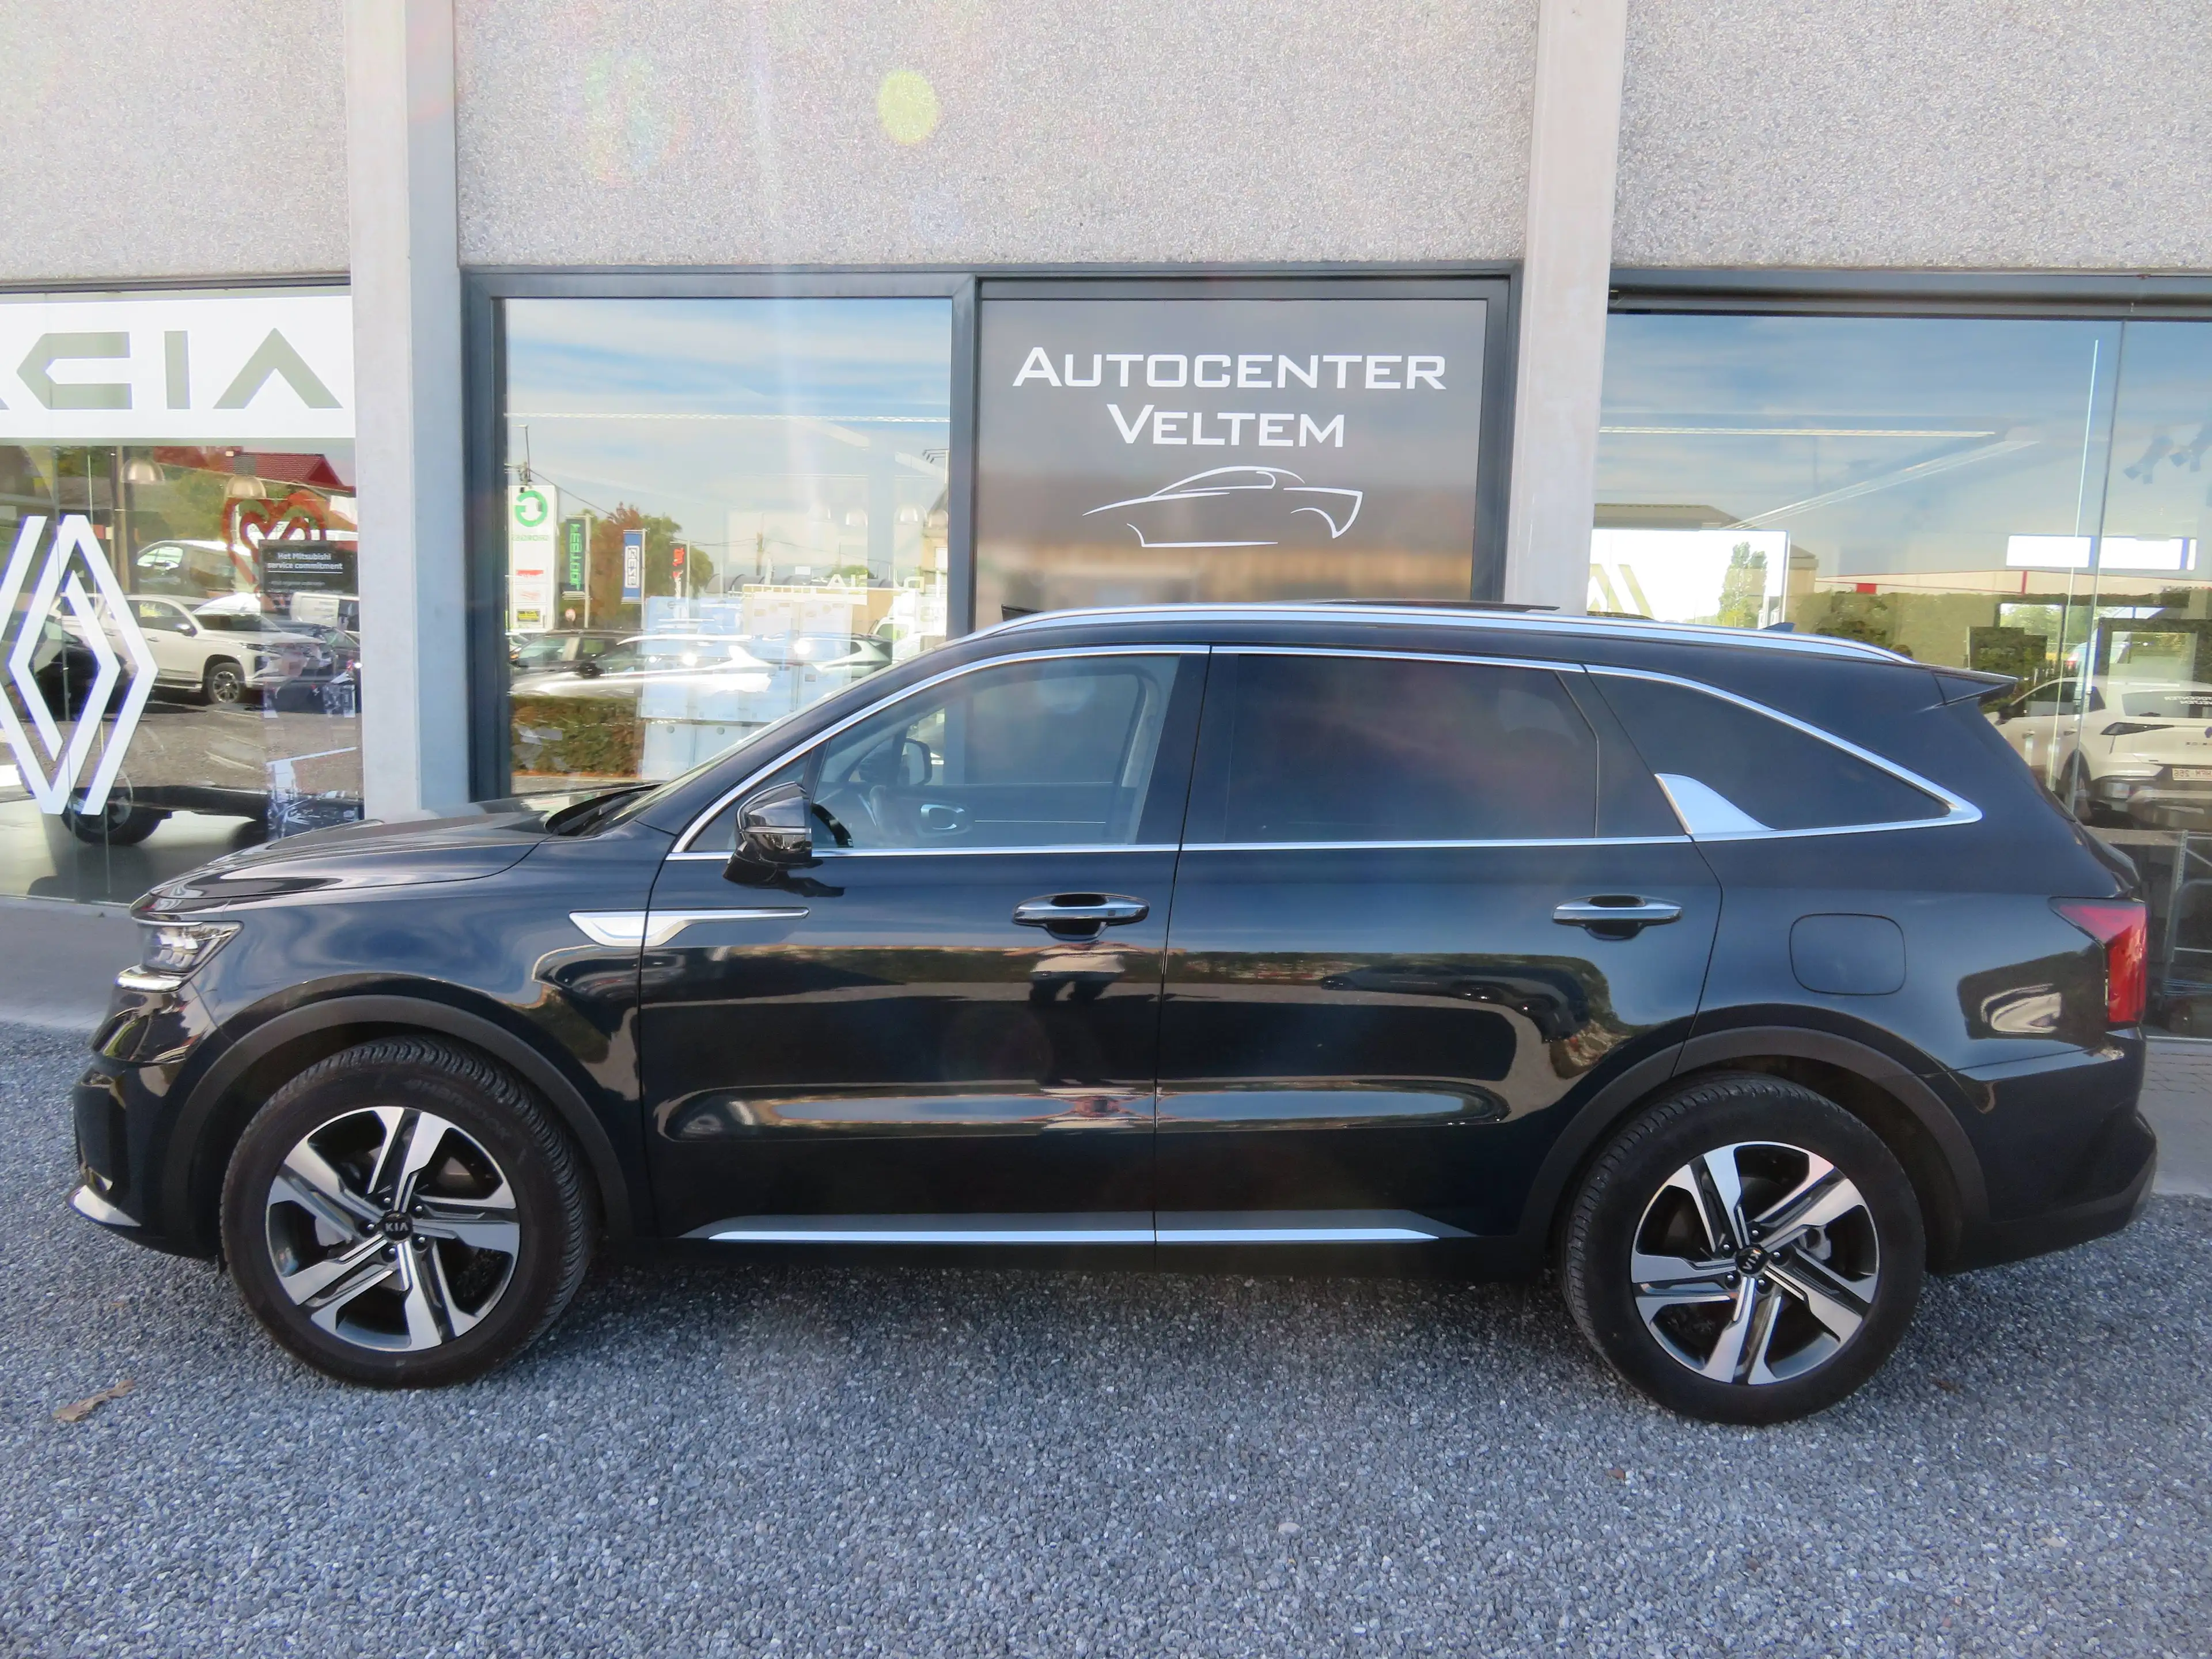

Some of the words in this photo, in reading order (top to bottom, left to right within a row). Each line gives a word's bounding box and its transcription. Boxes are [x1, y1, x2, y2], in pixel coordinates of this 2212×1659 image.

[0, 327, 343, 410] CIA
[1012, 347, 1447, 390] AUTOCENTER
[1107, 404, 1344, 448] VELTEM
[385, 1222, 409, 1232] KIA
[1743, 1253, 1759, 1270] KIA
